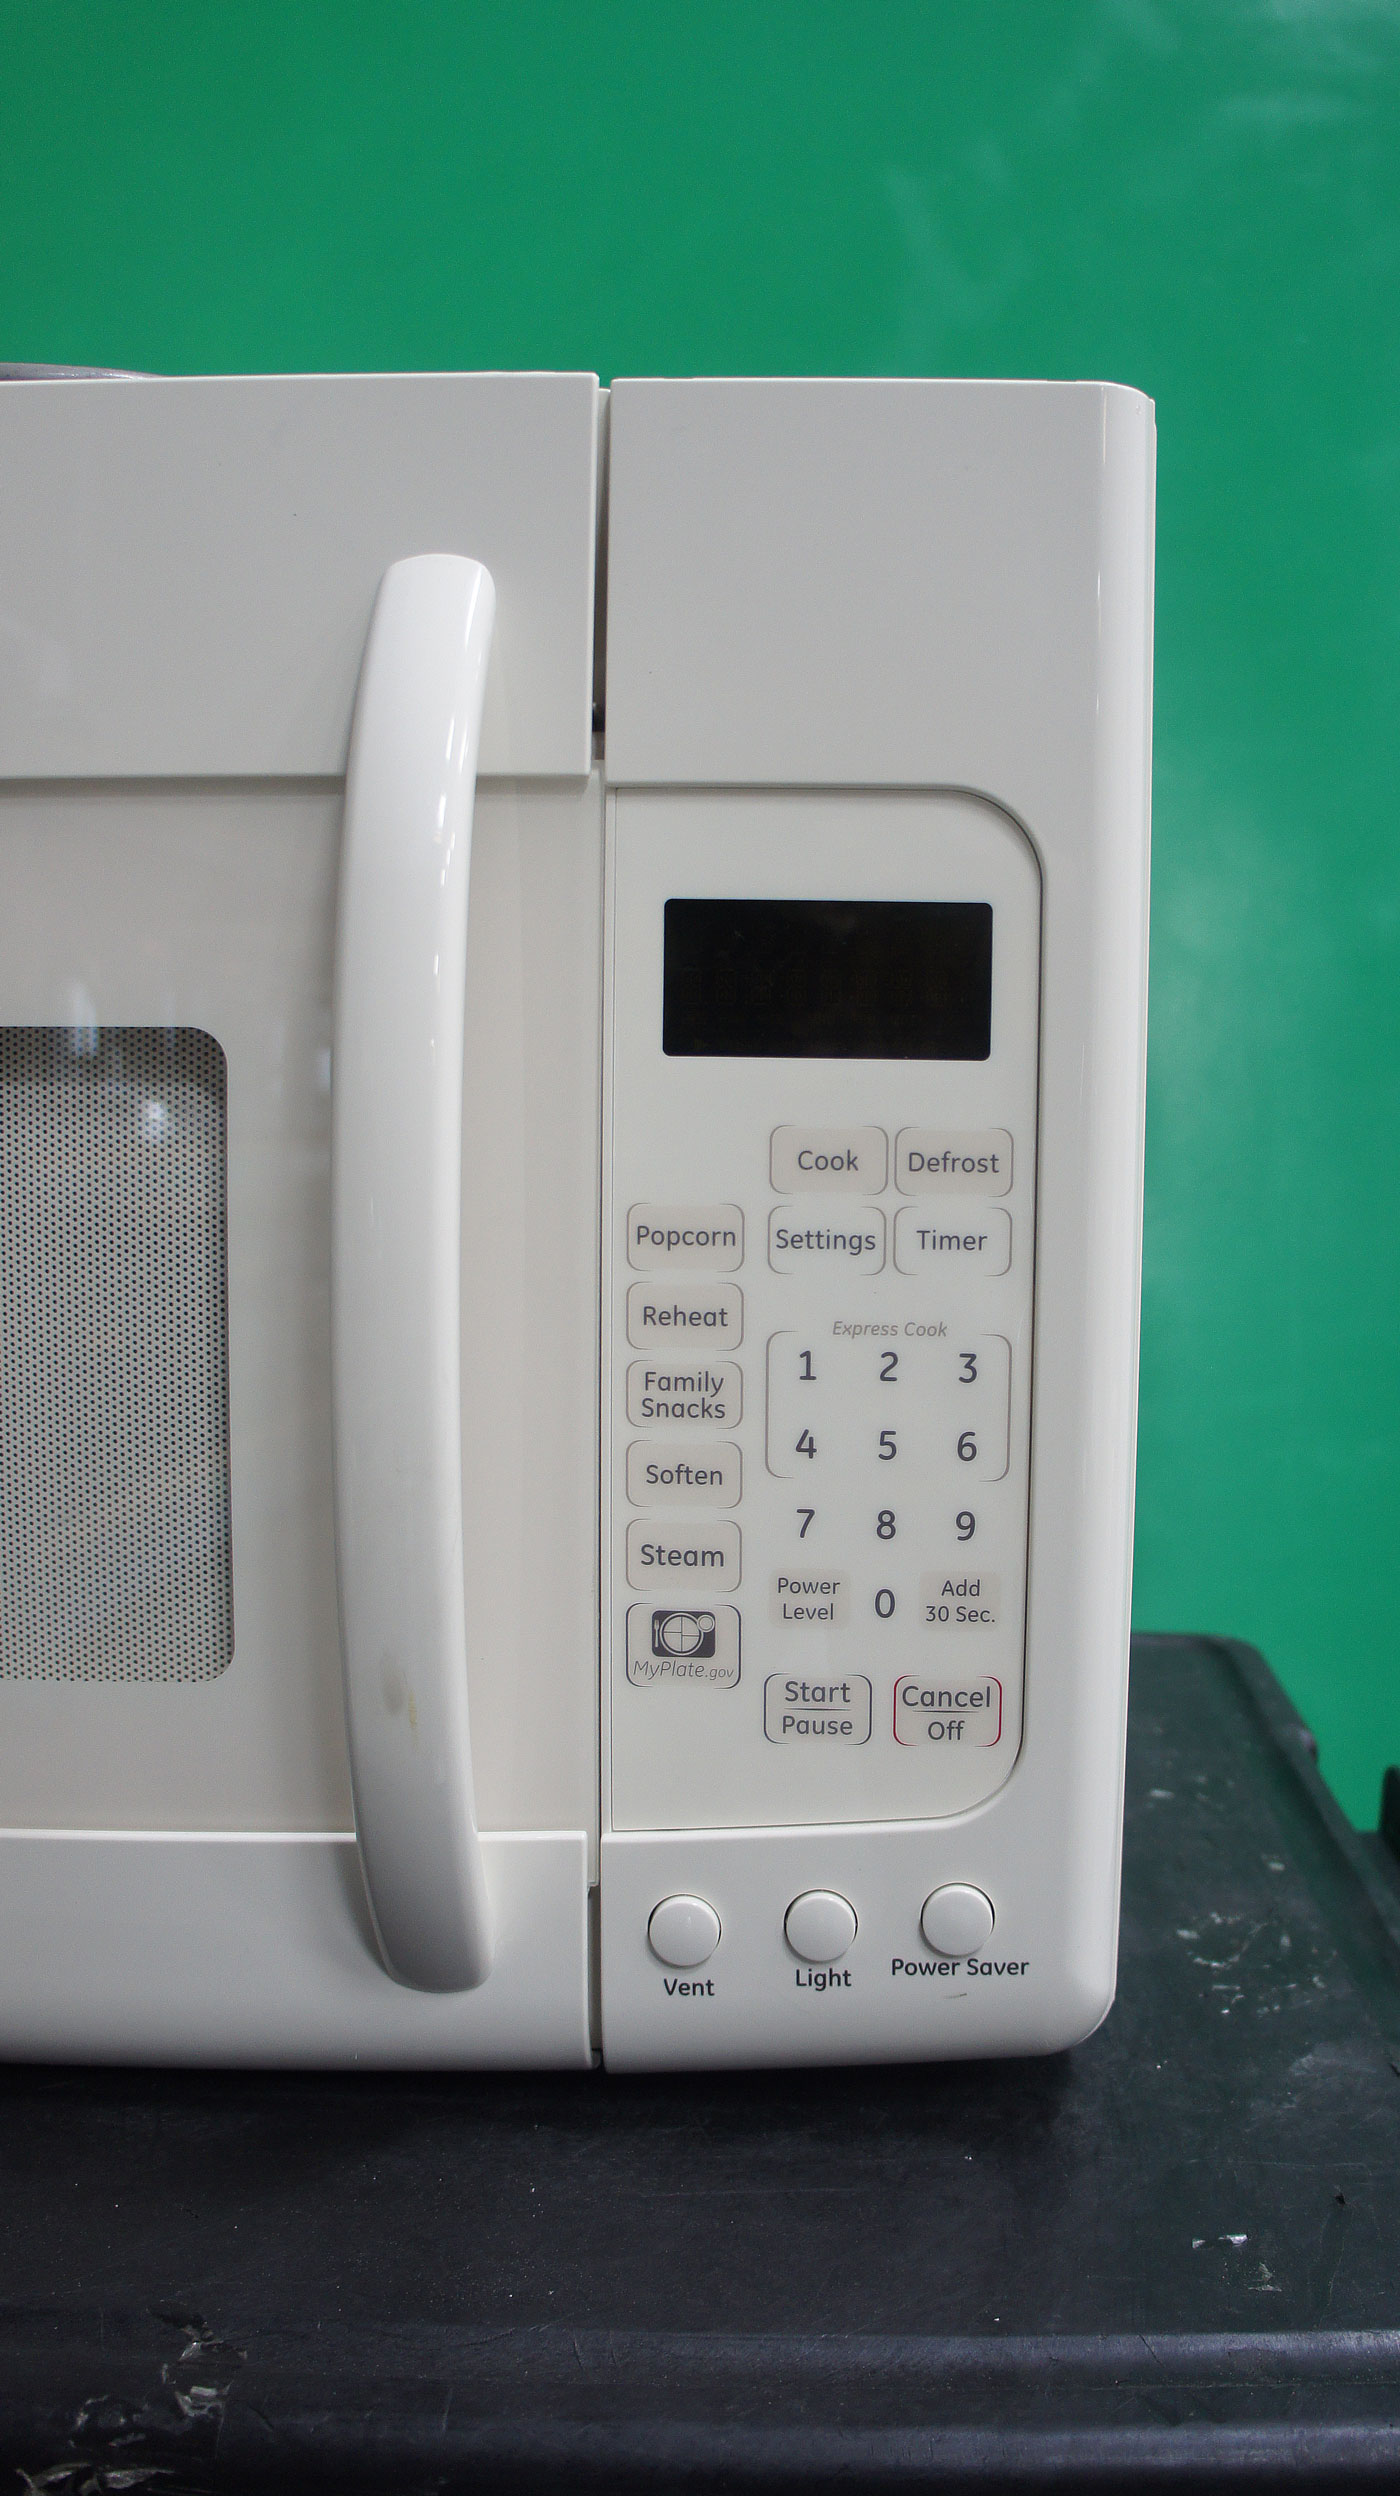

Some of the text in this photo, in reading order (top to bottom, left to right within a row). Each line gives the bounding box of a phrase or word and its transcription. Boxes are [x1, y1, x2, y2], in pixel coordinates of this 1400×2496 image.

[797, 1149, 859, 1172] Cook
[908, 1151, 1000, 1174] Defrost
[636, 1225, 737, 1251] Popcorn
[775, 1229, 877, 1256] Settings
[916, 1229, 988, 1251] Timer
[643, 1304, 729, 1327] Reheat
[832, 1320, 948, 1339] Express Cook
[799, 1350, 817, 1381] 1
[879, 1351, 899, 1382] 2
[958, 1352, 978, 1383] 3
[644, 1370, 725, 1397] Family
[641, 1397, 726, 1419] Snacks
[795, 1428, 818, 1460] 4
[878, 1430, 897, 1461] 5
[956, 1431, 978, 1462] 6
[645, 1463, 724, 1486] Soften
[796, 1508, 816, 1539] 7
[876, 1509, 897, 1540] 8
[955, 1510, 976, 1542] 9
[640, 1543, 725, 1568] Steam
[777, 1577, 841, 1595] Power
[941, 1578, 981, 1597] Add
[783, 1602, 835, 1621] Level
[874, 1588, 896, 1619] 0
[925, 1605, 996, 1624] 30 Sec.
[632, 1660, 734, 1680] MyPlate.gov
[784, 1680, 851, 1703] Start
[902, 1685, 991, 1708] Cancel
[782, 1715, 853, 1736] Pause
[927, 1719, 965, 1741] Off
[891, 1957, 1030, 1977] Power Saver
[663, 1978, 715, 1997] Vent
[795, 1967, 852, 1991] Light
